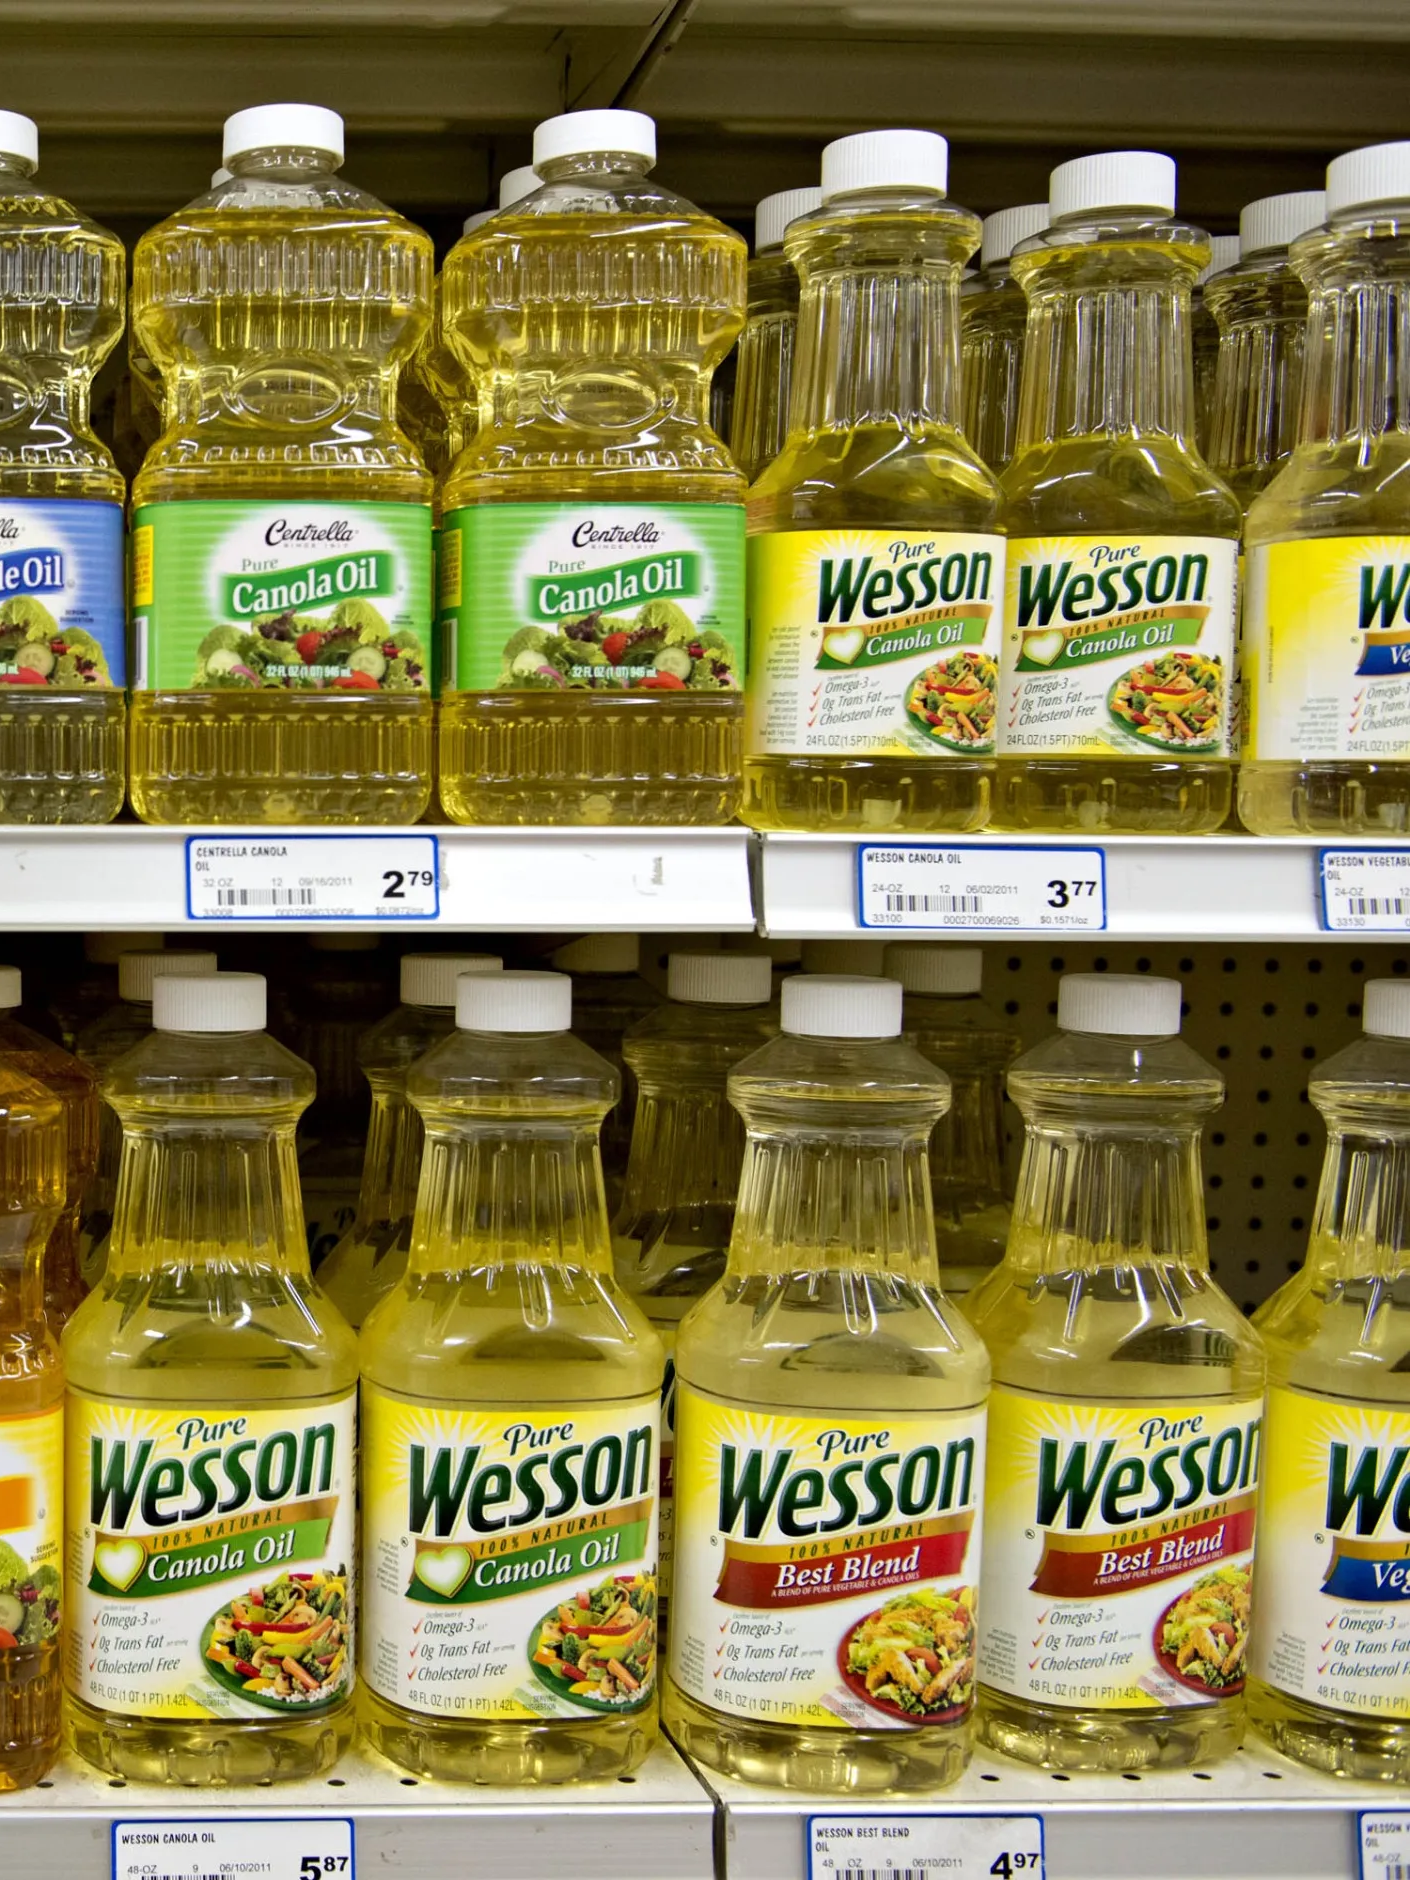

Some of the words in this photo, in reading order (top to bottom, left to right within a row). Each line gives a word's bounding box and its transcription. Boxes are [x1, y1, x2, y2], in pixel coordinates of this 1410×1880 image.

[265, 519, 355, 546] Centrella
[572, 521, 660, 548] Centrella
[242, 557, 278, 571] Pure
[889, 540, 935, 563] Pure
[1089, 544, 1141, 568] Pure
[23, 555, 64, 588] Oil
[549, 559, 585, 573] Pure
[232, 570, 332, 613] Canola
[336, 557, 378, 592] Oil
[539, 571, 638, 615] Canola
[642, 558, 683, 593] Oil
[818, 552, 992, 623] Wesson
[1018, 553, 1208, 627] Wesson
[866, 633, 932, 656] Canola
[936, 622, 964, 643] Oil
[1066, 634, 1138, 658] Canola
[1142, 623, 1175, 645] Oil
[196, 847, 248, 857] CENTRELLA
[251, 846, 288, 857] CANOLA
[866, 853, 904, 863] WESSON
[908, 853, 944, 864] CANOLA
[947, 854, 962, 864] OIL
[1328, 857, 1364, 866] WESSON
[195, 861, 210, 871] OIL
[1327, 871, 1341, 880] OIL
[872, 884, 903, 894] 24-OZ
[939, 884, 951, 894] 12
[966, 885, 1019, 895] 06/02/2011
[872, 914, 903, 923] 33100
[176, 1417, 246, 1450] Pure
[503, 1422, 573, 1456] Pure
[1139, 1414, 1203, 1449] Pure
[816, 1430, 890, 1461] Pure
[90, 1422, 335, 1530] Wesson
[409, 1424, 652, 1537] Wesson
[718, 1436, 974, 1539] Wesson
[479, 1537, 519, 1556] 100%
[531, 1514, 609, 1544] NATURAL
[148, 1547, 246, 1582] Canola
[253, 1530, 296, 1563] Oil
[474, 1550, 572, 1587] Canola
[580, 1533, 620, 1564] Oil
[1097, 1551, 1153, 1576] Best
[1160, 1524, 1226, 1564] Blend
[775, 1563, 835, 1588] Best
[842, 1546, 920, 1581] Blend
[778, 1586, 799, 1597] BLEND
[801, 1586, 811, 1595] OF
[812, 1584, 831, 1594] PURE
[833, 1579, 869, 1592] VEGETABLE
[877, 1575, 904, 1587] CANOLA
[905, 1573, 919, 1582] OILS
[423, 1617, 474, 1637] Omega-3
[438, 1641, 468, 1657] Trans
[472, 1639, 490, 1654] Fat
[417, 1668, 480, 1682] Cholesterol
[484, 1662, 507, 1676] Free
[121, 1834, 160, 1845] WESSON
[163, 1833, 198, 1844] CANOLA
[202, 1833, 216, 1843] OIL
[816, 1828, 853, 1838] WESSON
[857, 1828, 878, 1838] BEST
[882, 1828, 910, 1838] BLEND
[815, 1842, 829, 1852] OIL
[127, 1865, 157, 1874] 48-OZ
[219, 1863, 271, 1874] 06/10/2011
[822, 1859, 834, 1868] 48
[848, 1859, 862, 1868] OZ
[912, 1858, 963, 1868] 06/10/2011
